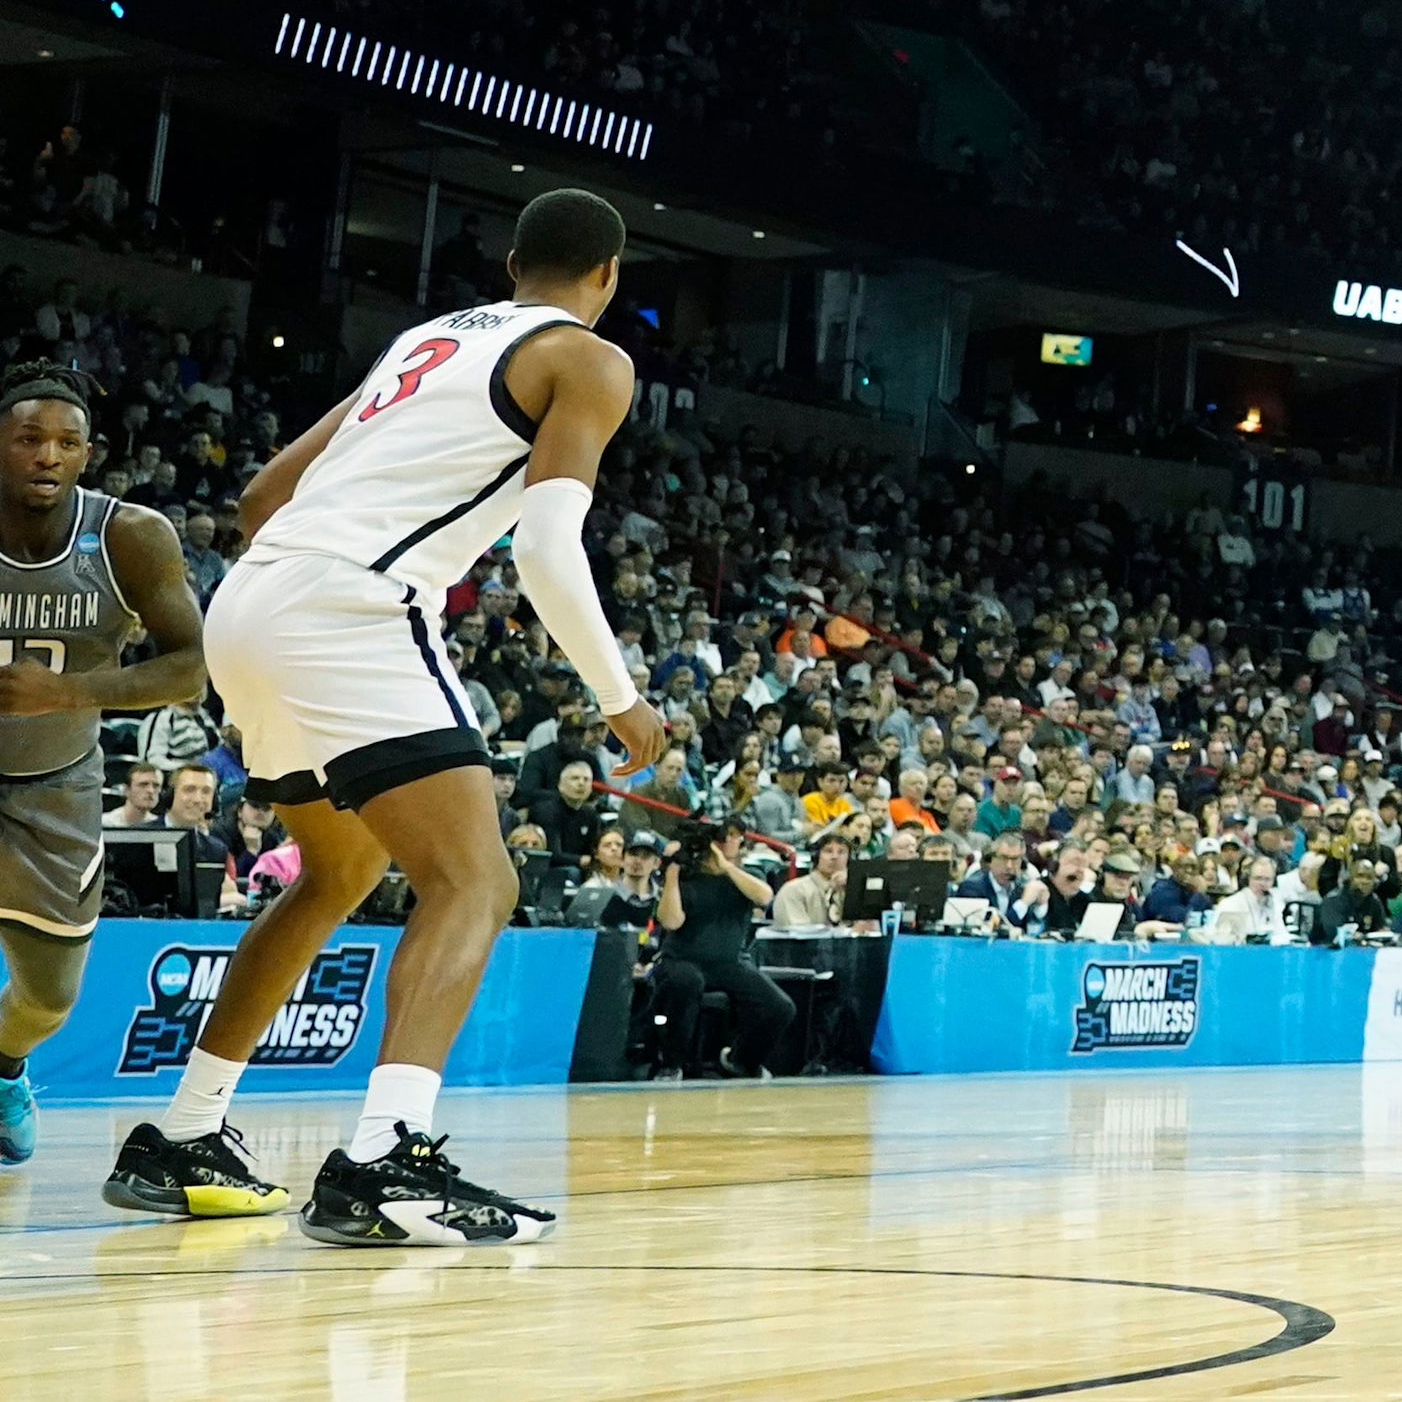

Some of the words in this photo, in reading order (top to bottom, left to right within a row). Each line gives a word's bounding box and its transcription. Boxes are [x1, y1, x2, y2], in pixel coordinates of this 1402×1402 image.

[358, 337, 460, 422] 3
[1243, 478, 1305, 532] 101
[1102, 967, 1168, 1001] MARCH
[195, 1002, 359, 1048] NESS
[1110, 1000, 1196, 1035] MADNESS
